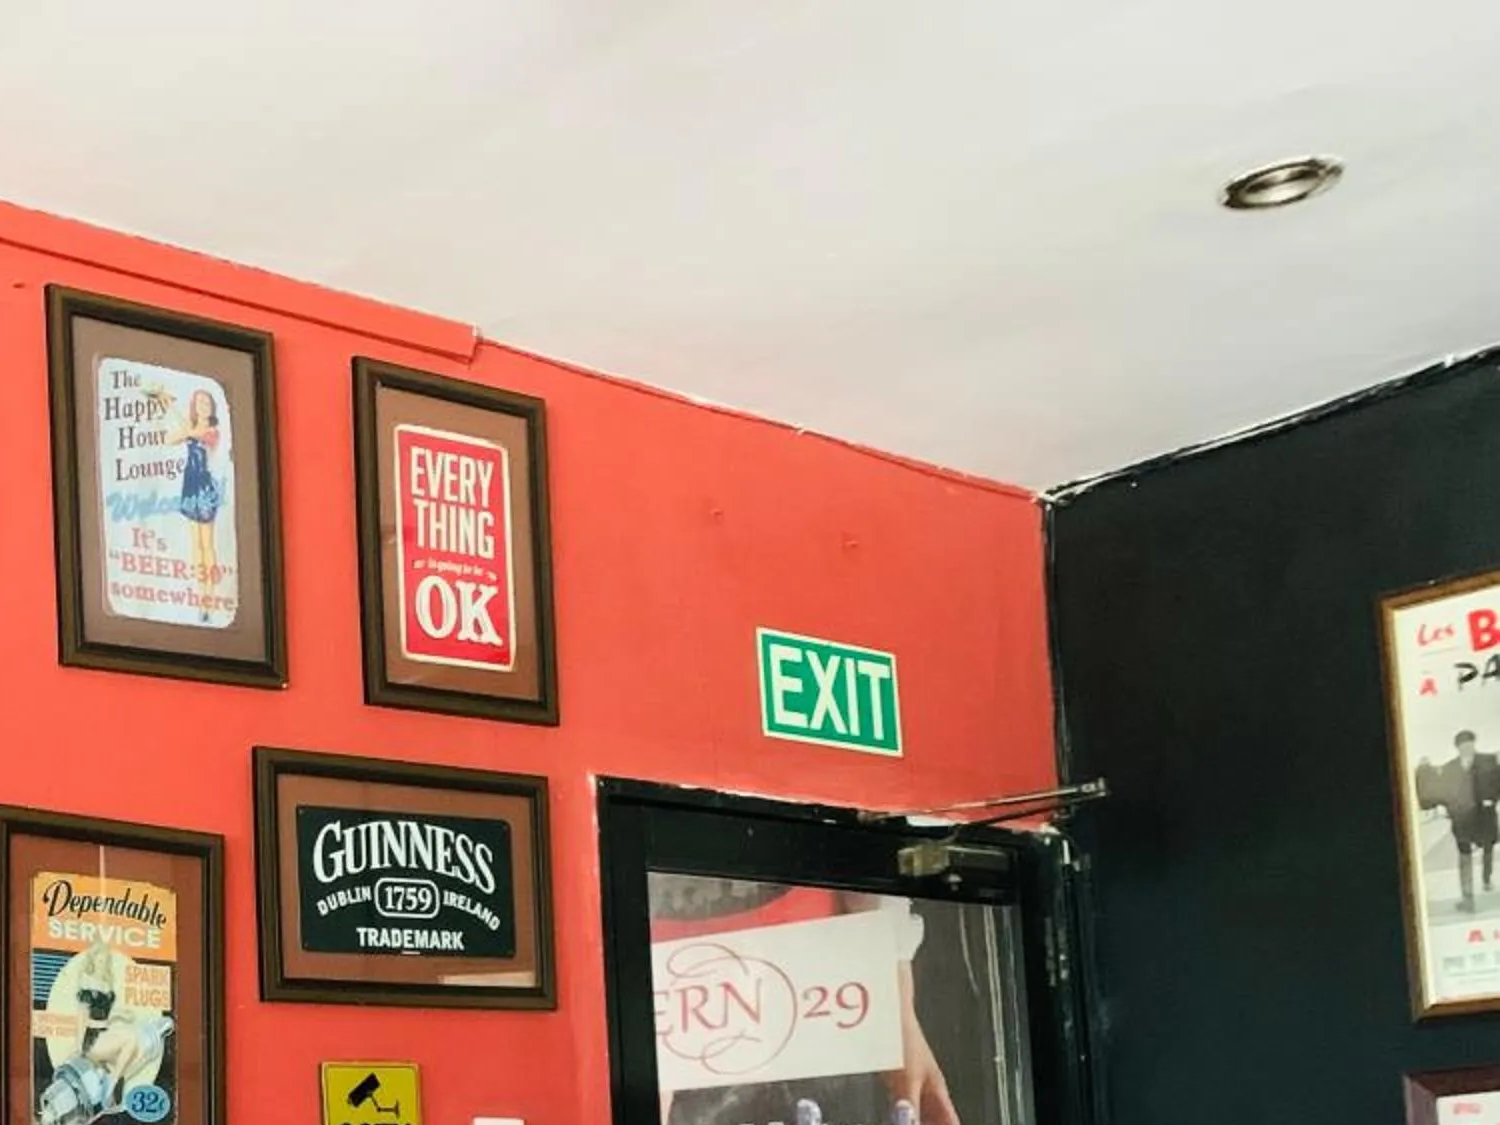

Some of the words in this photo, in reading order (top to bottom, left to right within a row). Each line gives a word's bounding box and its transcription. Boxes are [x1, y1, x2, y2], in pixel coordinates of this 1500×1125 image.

[104, 396, 169, 422] Happy
[118, 426, 167, 450] Hour
[115, 456, 186, 482] Lounge
[410, 446, 494, 509] EVERY
[412, 498, 495, 559] THING
[415, 575, 503, 646] OK
[768, 643, 891, 741] EXIT
[313, 819, 496, 895] GUINNESS
[43, 879, 168, 930] Dependable
[316, 885, 373, 917] DUBLIN
[384, 886, 432, 913] 1759
[443, 889, 501, 931] IRELAND
[49, 918, 162, 949] SERVICE
[356, 927, 465, 950] TRADEMARK
[802, 981, 870, 1030] 29
